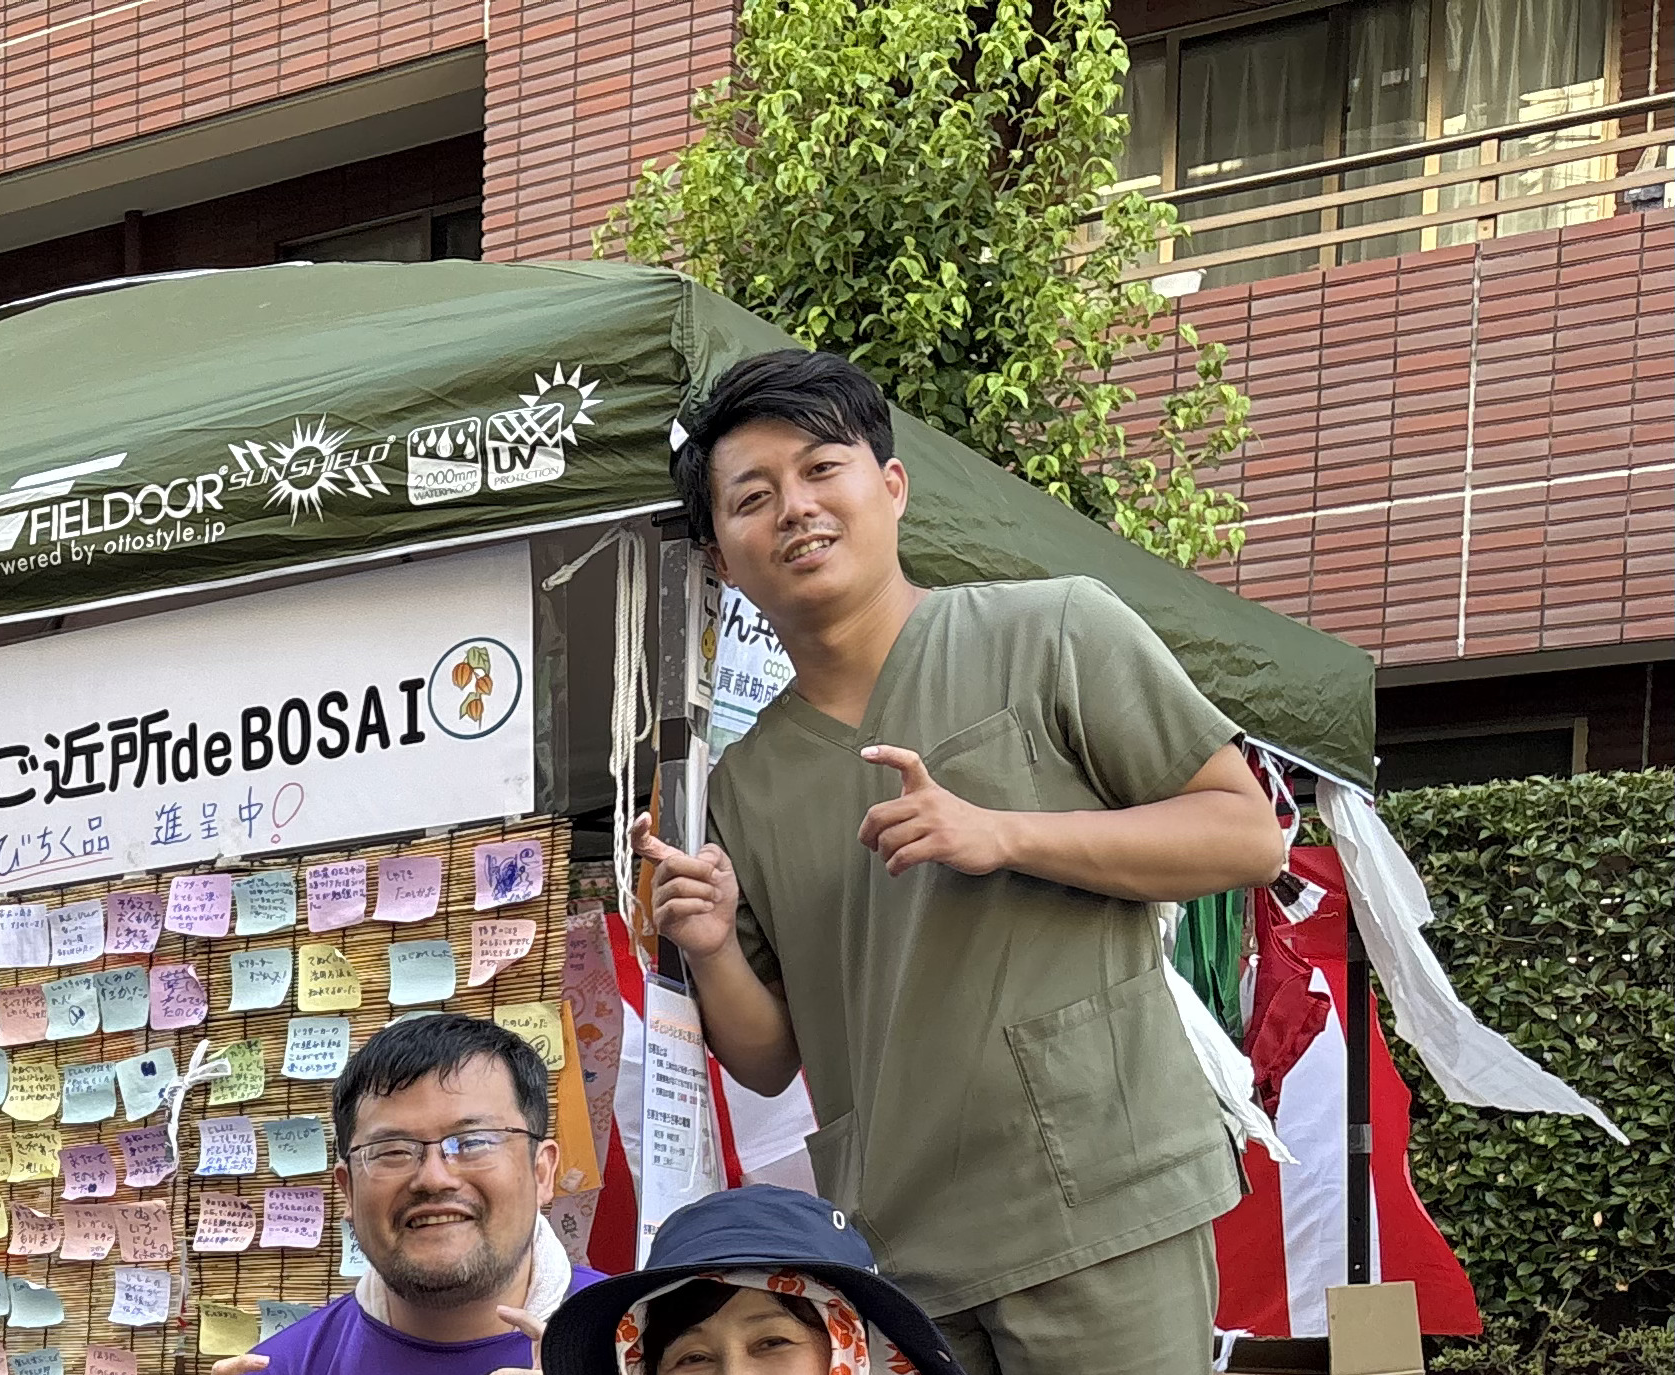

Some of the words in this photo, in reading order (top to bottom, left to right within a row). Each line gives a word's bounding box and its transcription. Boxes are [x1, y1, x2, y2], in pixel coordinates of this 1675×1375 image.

[228, 444, 390, 491] SUNSHIELD
[493, 445, 537, 474] UV
[29, 473, 223, 545] FIELDOOR
[71, 540, 95, 565] by
[104, 518, 225, 555] ottostyle.jp
